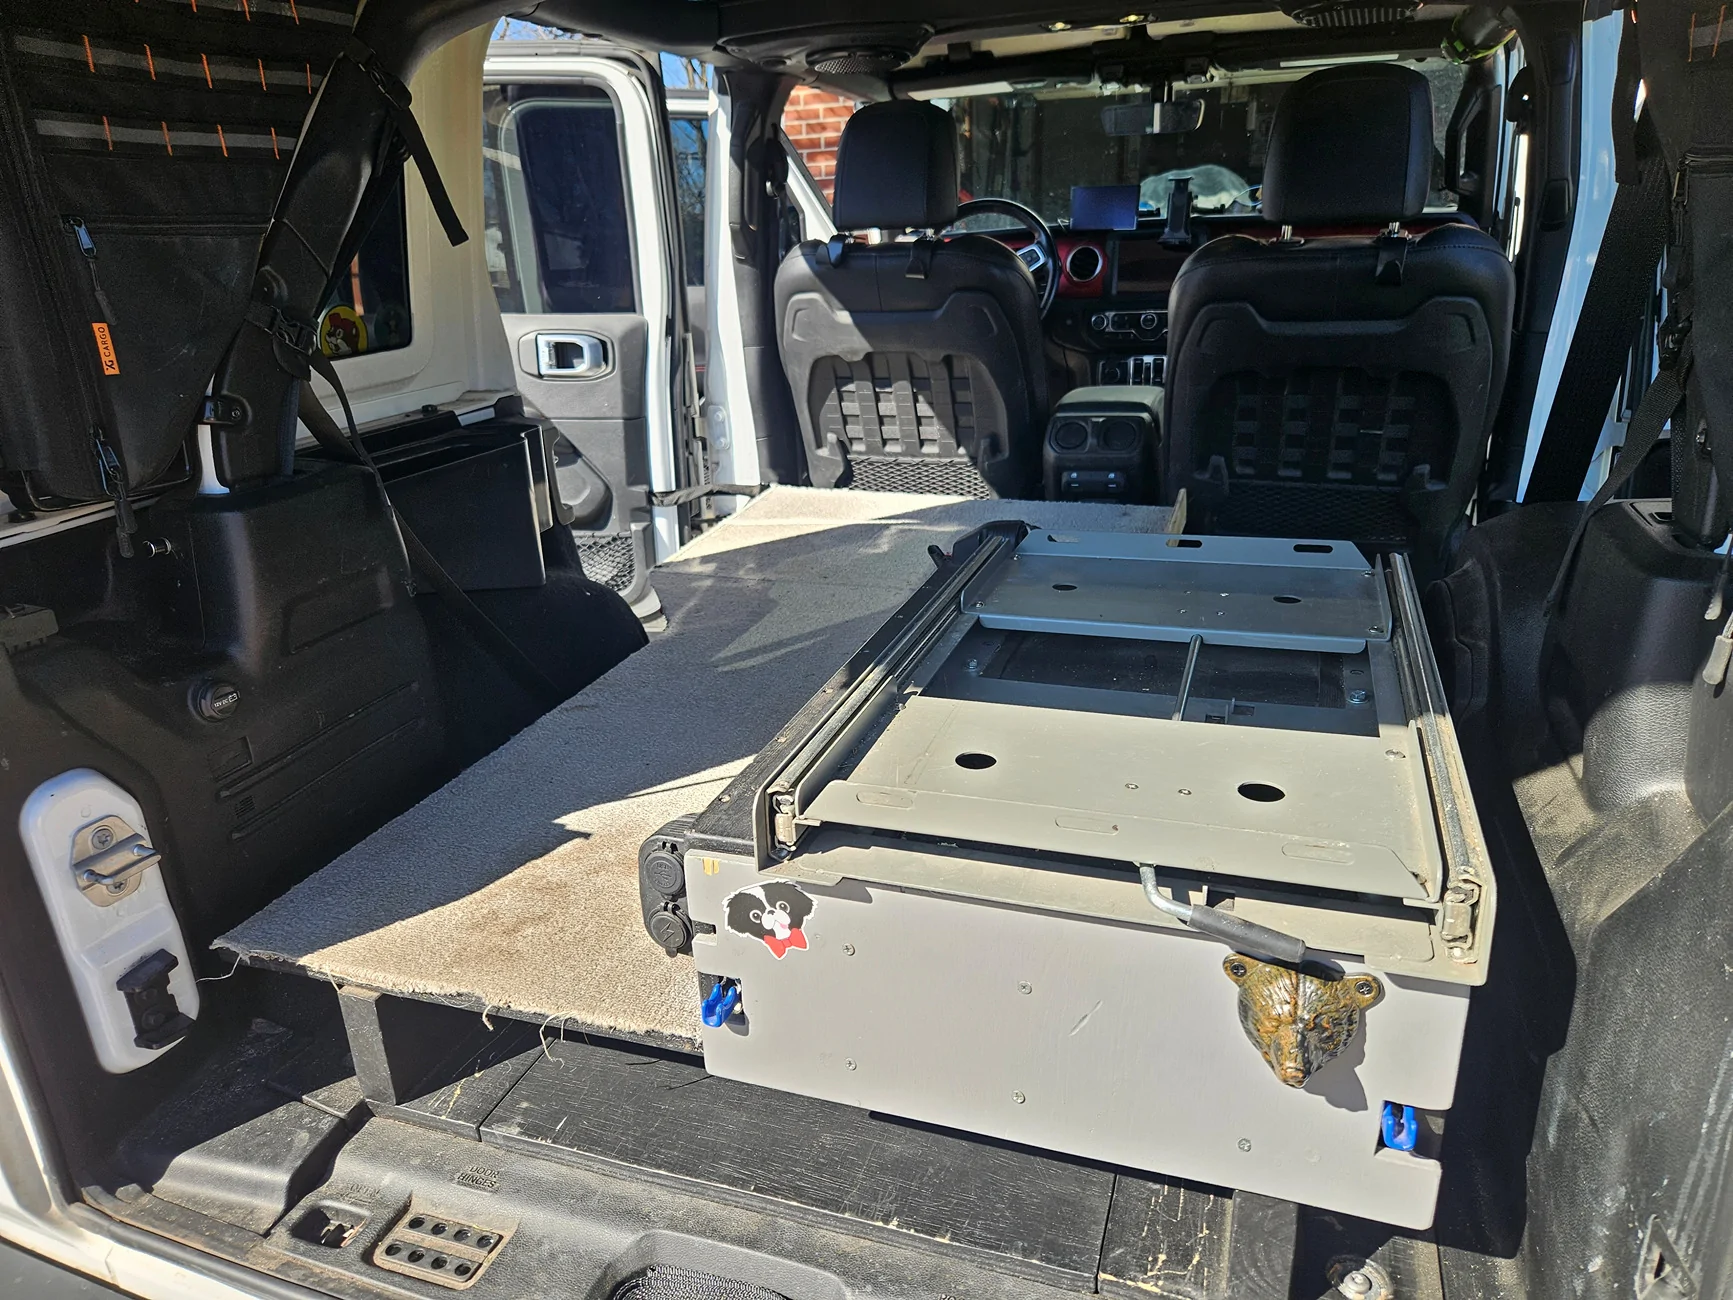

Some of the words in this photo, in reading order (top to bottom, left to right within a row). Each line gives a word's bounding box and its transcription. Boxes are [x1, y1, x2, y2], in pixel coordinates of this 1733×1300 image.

[97, 326, 113, 358] CARGO
[457, 1172, 497, 1188] HINGES
[469, 1165, 500, 1179] DOOR
